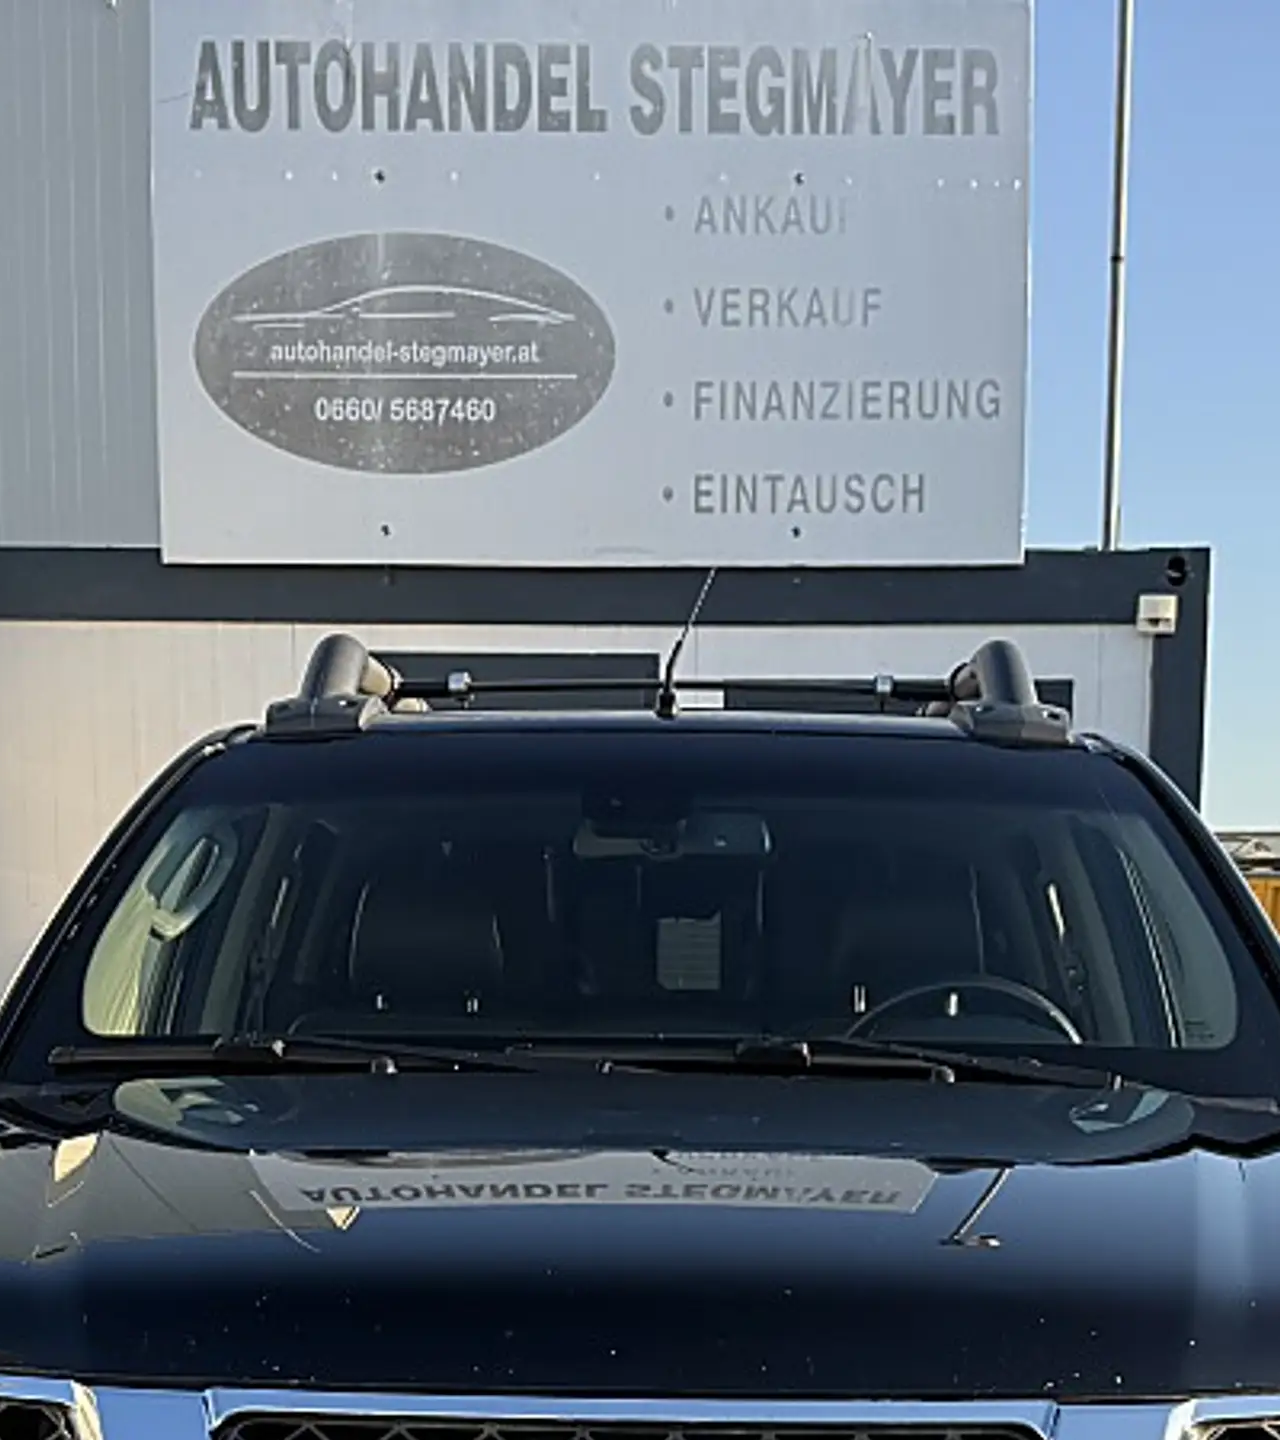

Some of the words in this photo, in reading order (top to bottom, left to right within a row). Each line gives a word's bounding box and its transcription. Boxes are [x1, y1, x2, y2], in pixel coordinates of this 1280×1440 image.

[189, 39, 608, 133] AUTOHANDEL
[628, 42, 1001, 137] STEGMAYER
[693, 287, 883, 327] VERKAUF
[270, 340, 540, 367] autohandel-stegmayer.at
[315, 397, 382, 422] 0660/
[390, 398, 495, 426] 5687460
[693, 379, 1001, 421] FINANZIERUNG
[693, 473, 926, 515] EINTAUSCH
